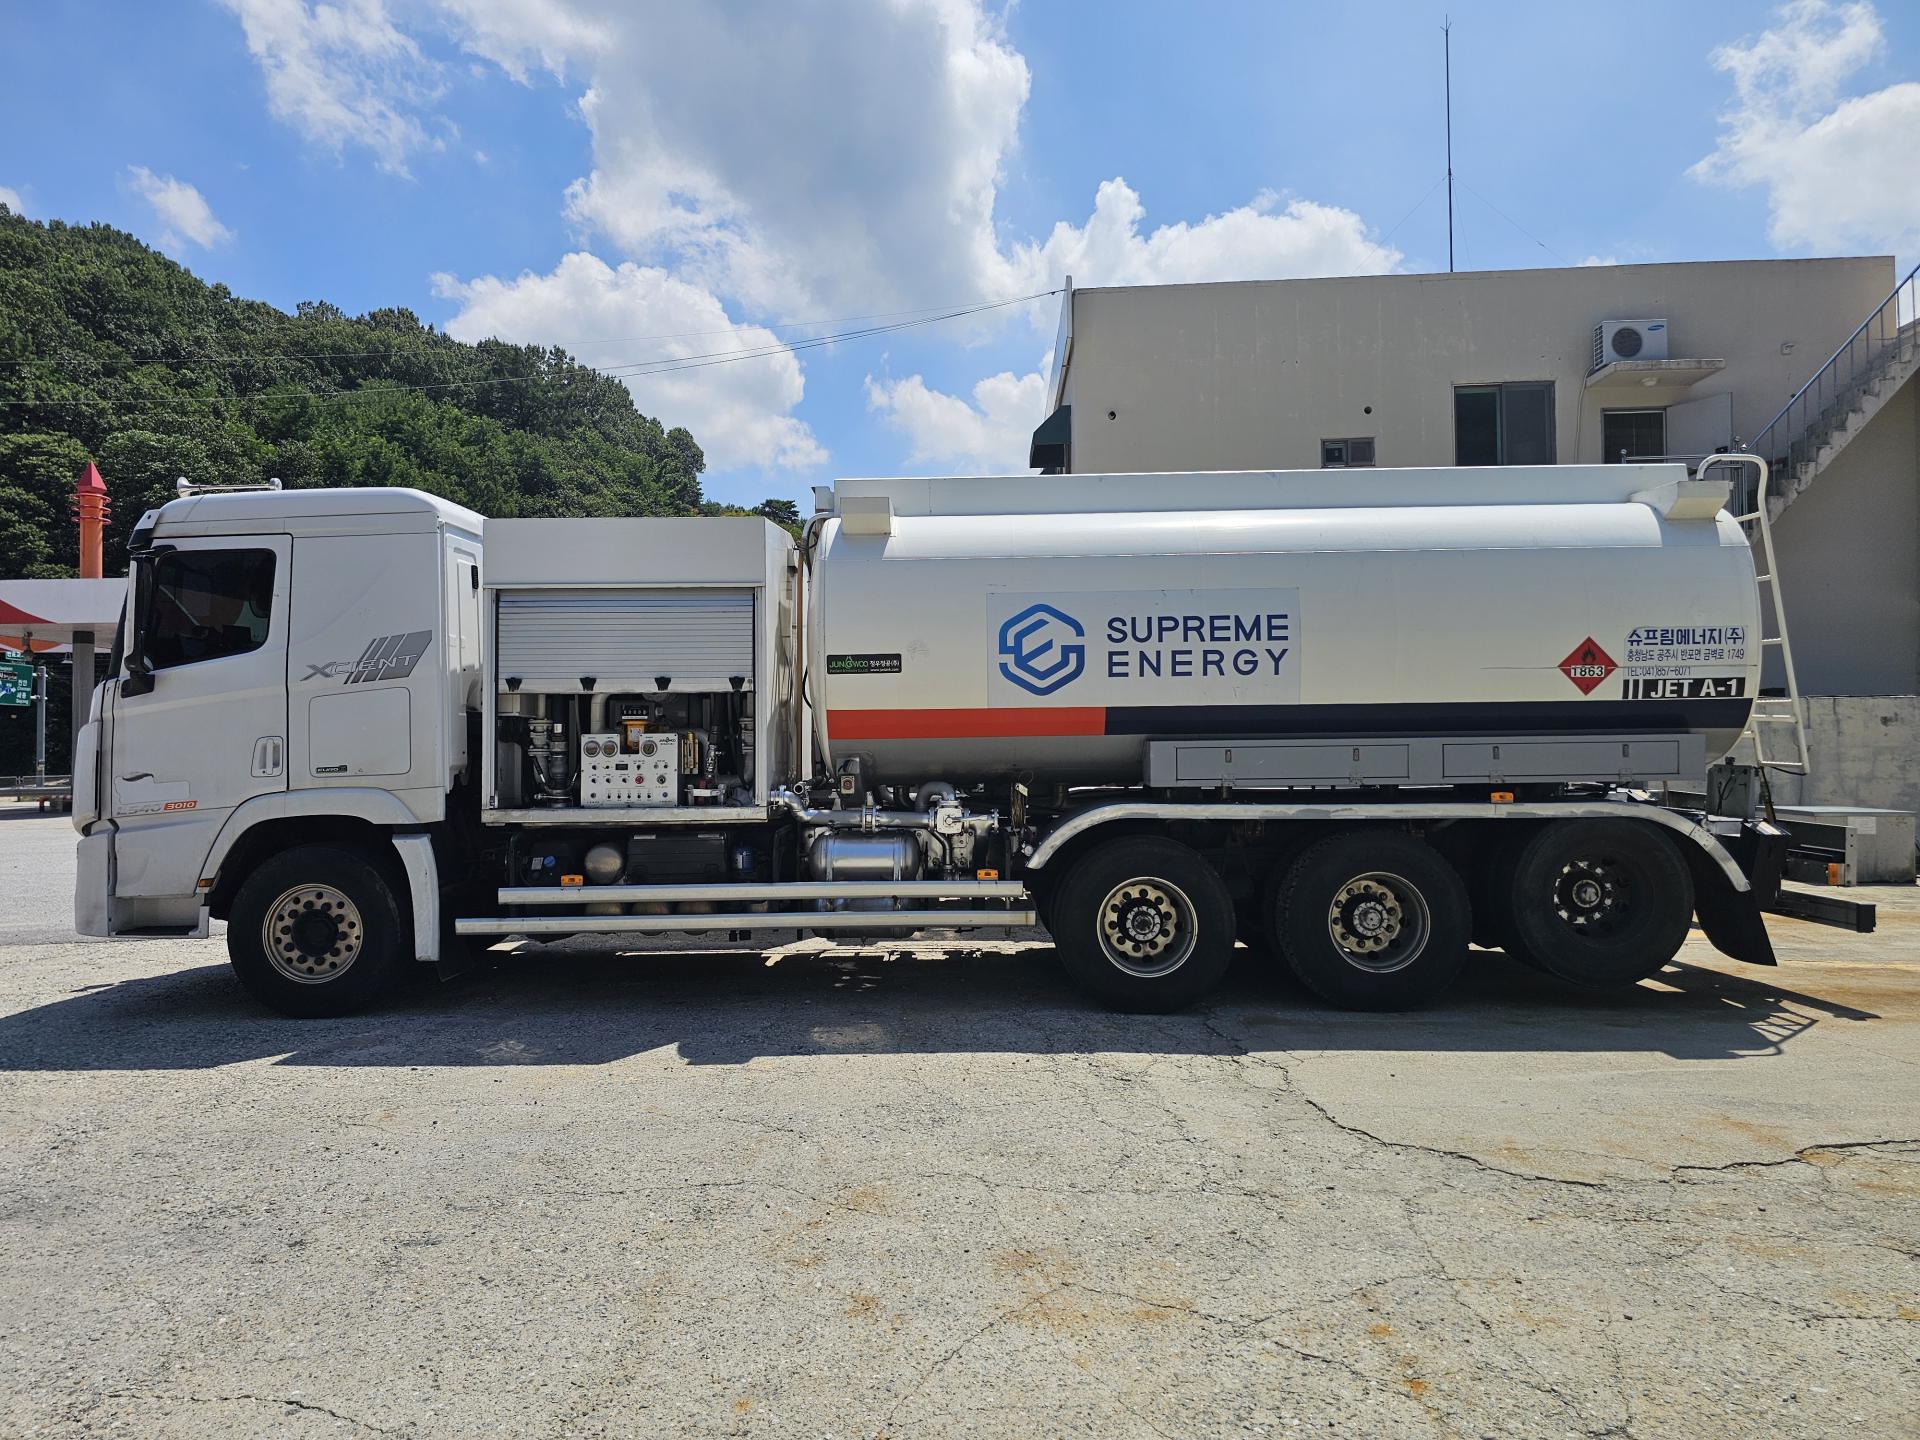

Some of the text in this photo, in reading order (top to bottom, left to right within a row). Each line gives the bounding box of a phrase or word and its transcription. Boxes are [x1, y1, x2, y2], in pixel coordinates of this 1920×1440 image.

[1106, 614, 1289, 643] SUPREME
[1627, 627, 1745, 646] 슈프림에너지(주)
[1107, 648, 1289, 678] ENERGY
[1627, 648, 1745, 662] 충청남도 공주시 반포면 금벽로 1749
[299, 654, 418, 681] XCIENT
[1571, 666, 1604, 677] 1863
[1650, 678, 1737, 698] JET A-1
[167, 801, 195, 810] 3010
